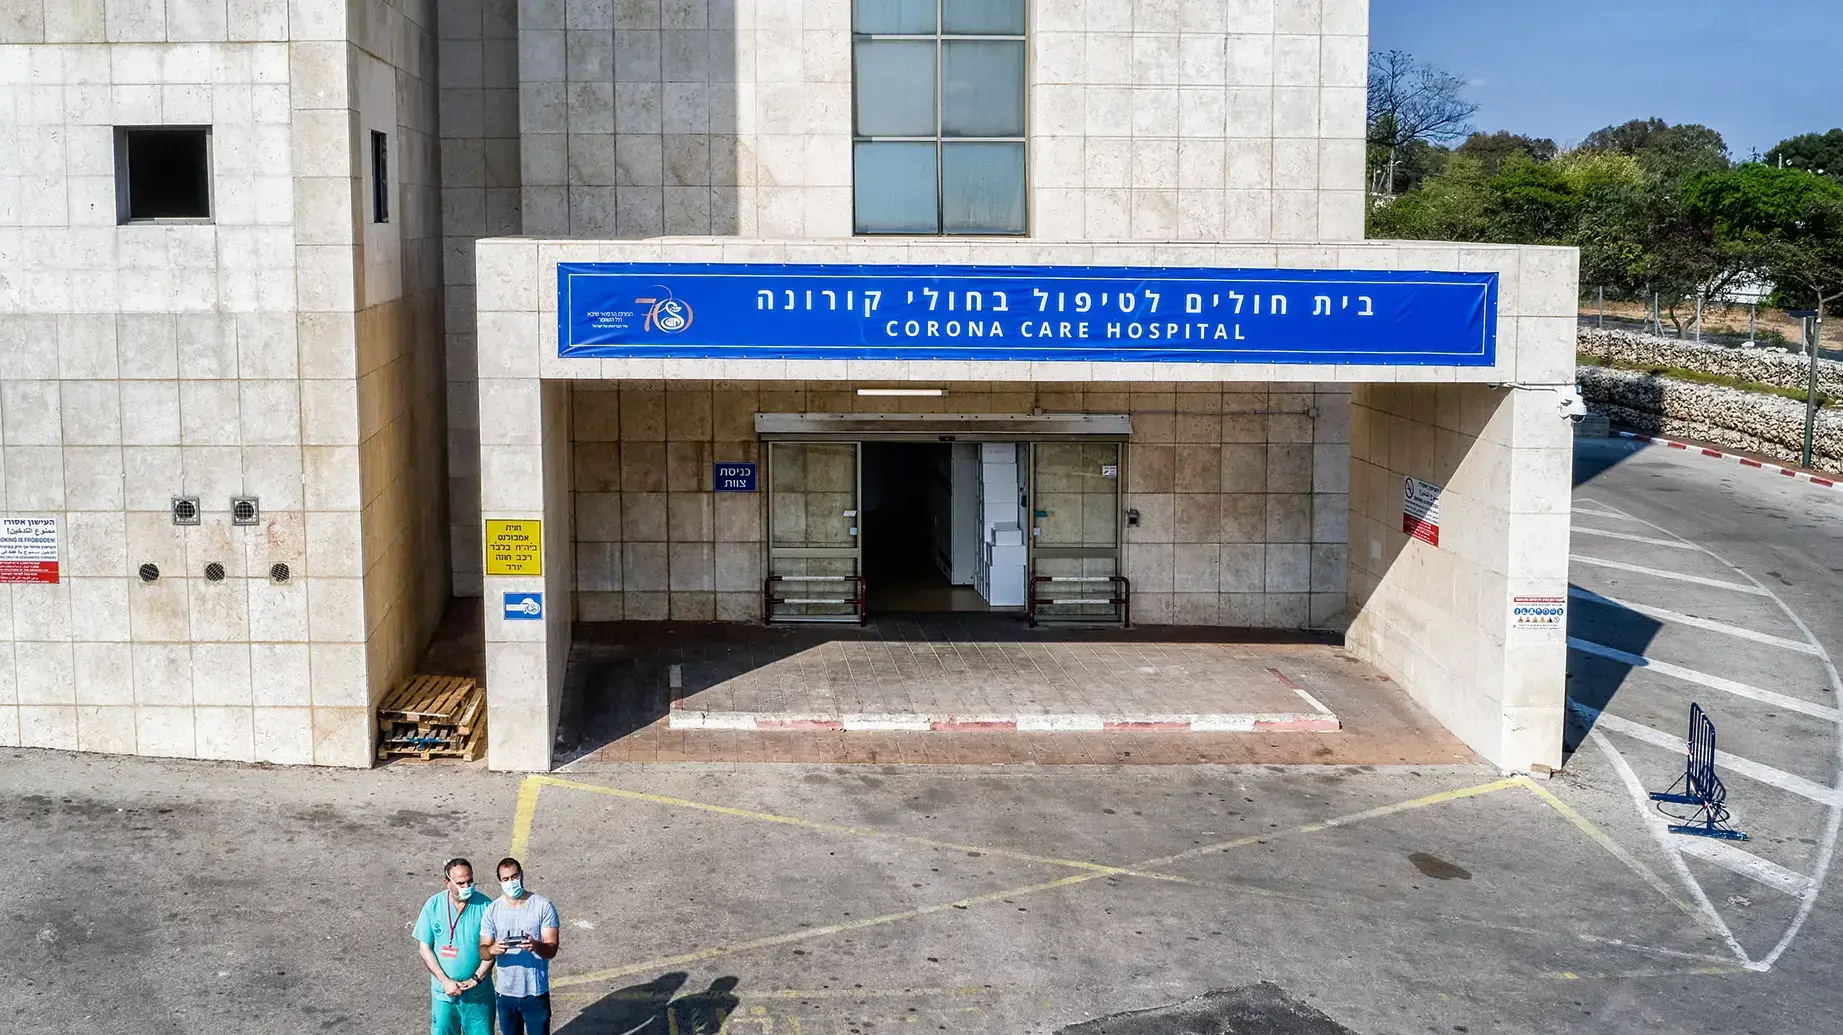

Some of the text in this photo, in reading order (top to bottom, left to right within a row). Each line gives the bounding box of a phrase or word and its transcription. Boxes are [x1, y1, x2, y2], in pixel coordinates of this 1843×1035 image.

[757, 286, 1374, 317] בית חולים לטיפול בחולי קורונה
[886, 320, 1245, 340] CORONA CARE HOSPITAL
[719, 468, 751, 476] כניסת
[724, 479, 746, 488] צוות
